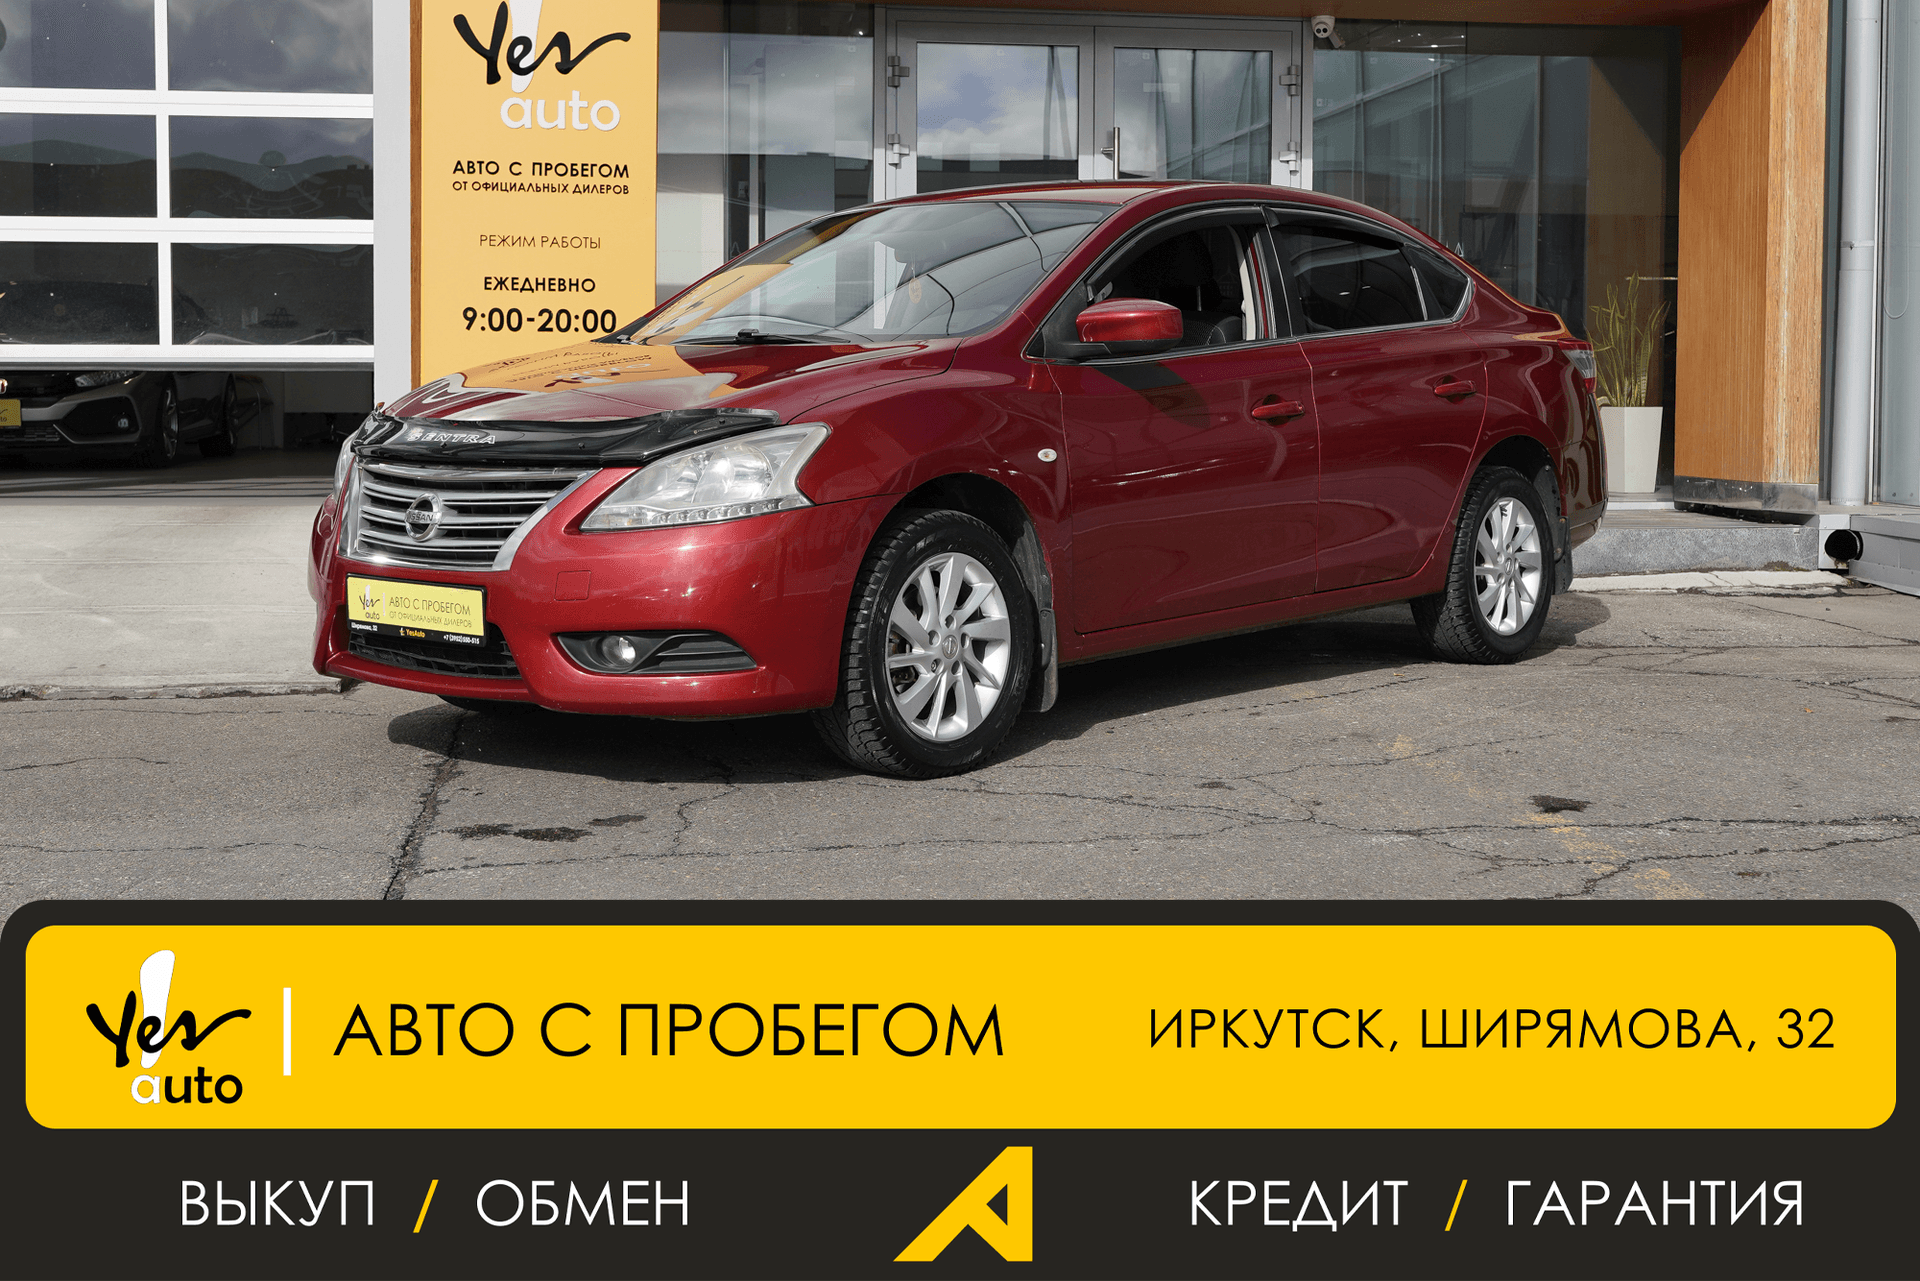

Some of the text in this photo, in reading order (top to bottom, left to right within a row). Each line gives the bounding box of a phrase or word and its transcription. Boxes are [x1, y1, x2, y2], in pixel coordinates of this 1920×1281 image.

[500, 89, 621, 131] auto
[453, 160, 630, 179] АВТО С ПРОБЕГОМ
[452, 180, 630, 195] ОТ ОФИЦИАЛЬНЫХ ДИЛЕРОВ
[479, 234, 601, 249] РЕЖИМ РАБОТЫ
[484, 276, 596, 293] ЕЖЕДНЕВНО
[462, 306, 617, 334] 9:00-20:00
[407, 432, 497, 445] SENTRA
[389, 596, 472, 617] АВТО С ПРОБЕГОМ
[365, 611, 381, 620] auto
